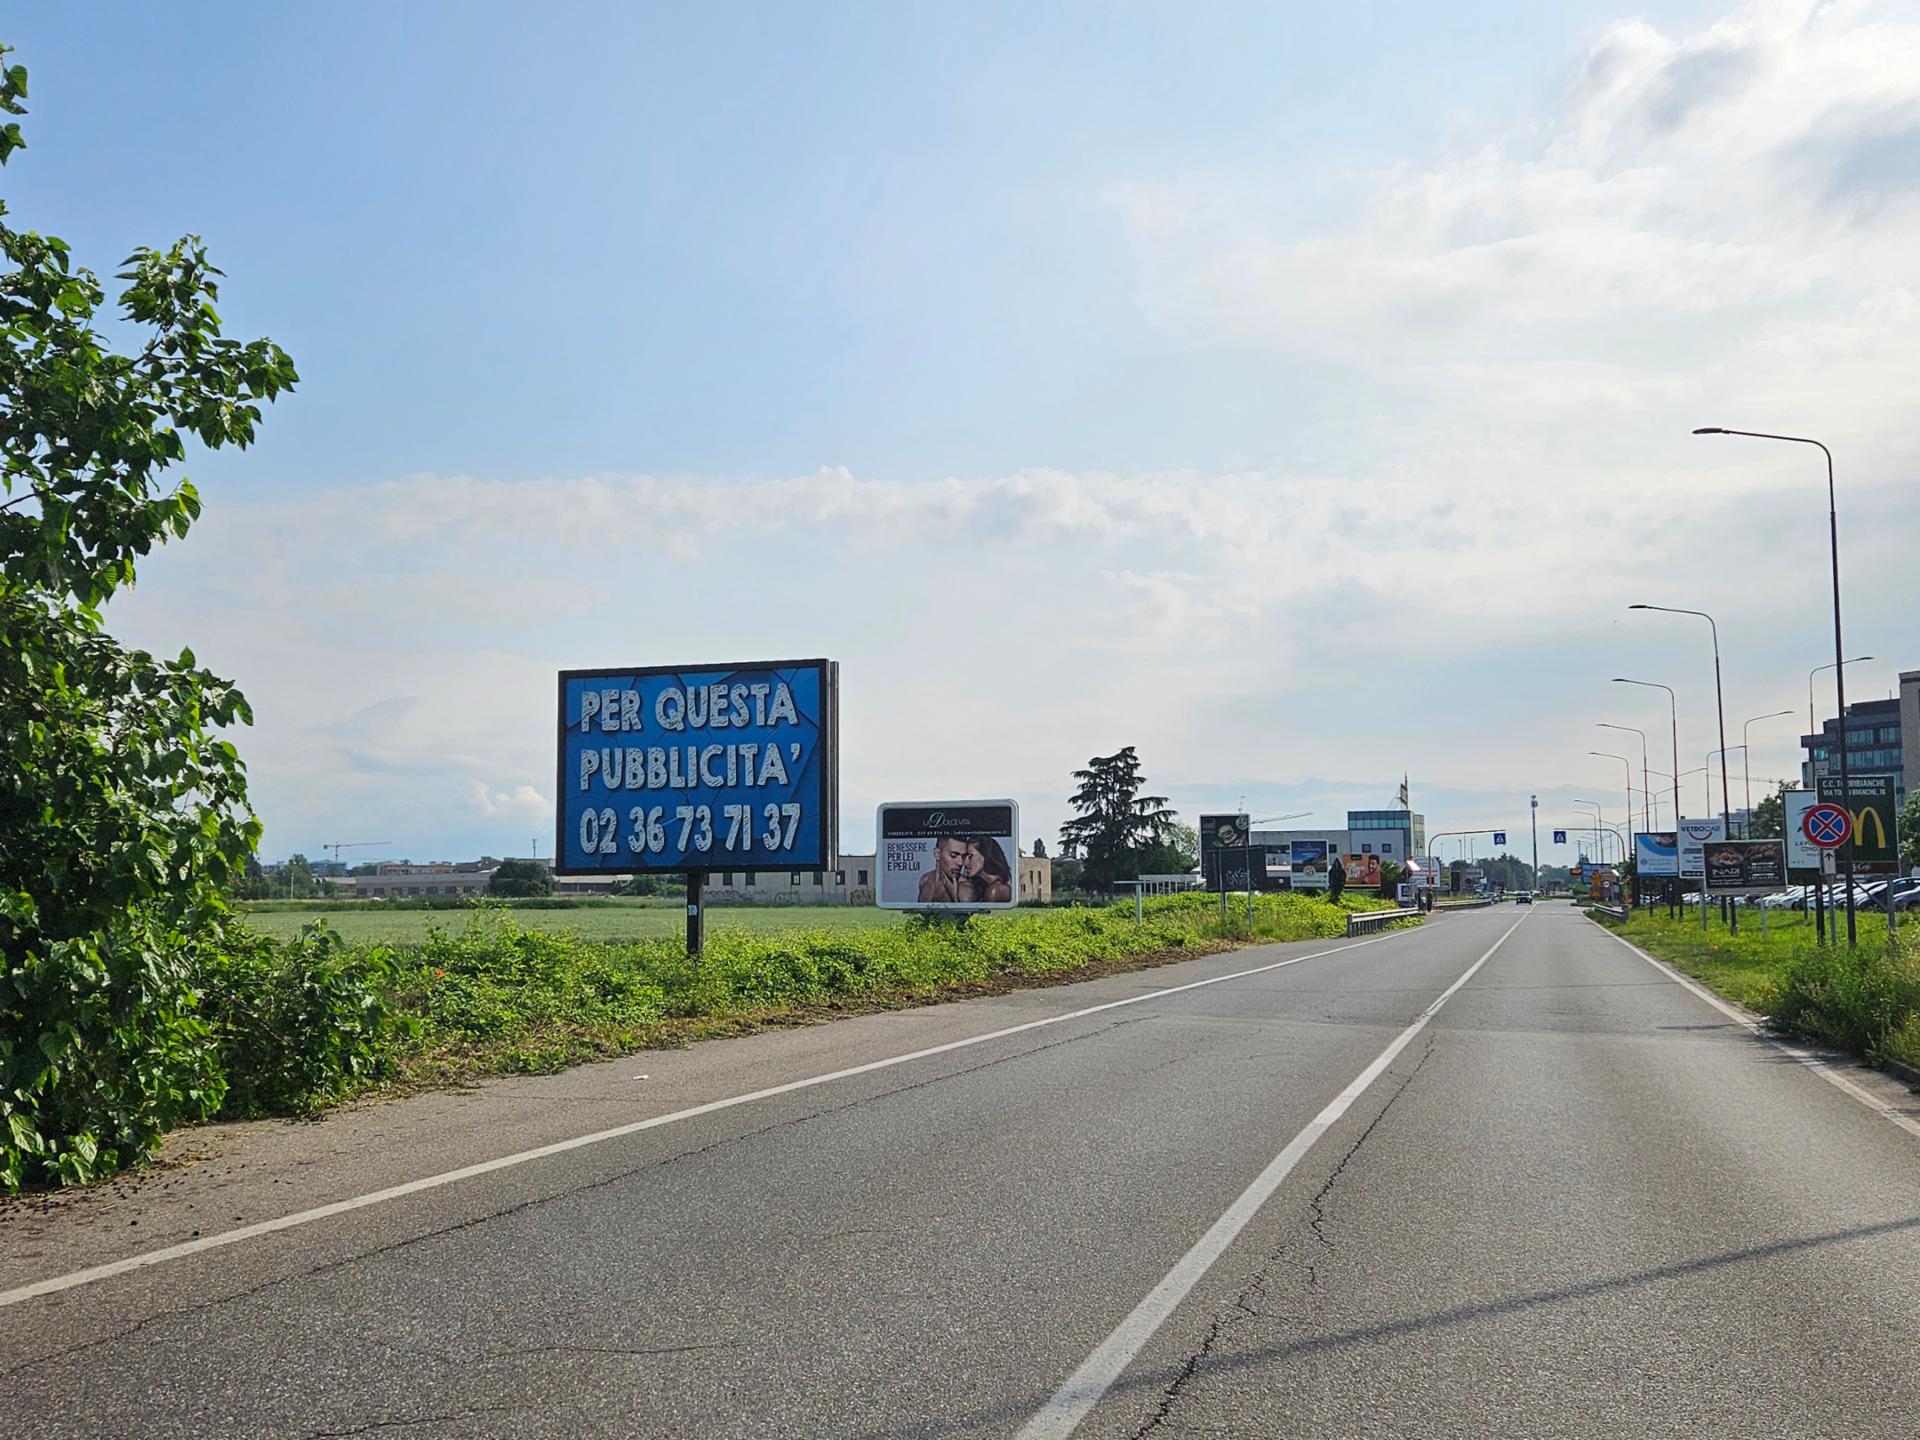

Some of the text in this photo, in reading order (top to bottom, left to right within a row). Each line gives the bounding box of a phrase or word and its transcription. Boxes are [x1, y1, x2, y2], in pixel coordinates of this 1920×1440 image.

[580, 683, 798, 733] PER QUESTA
[580, 742, 800, 791] PUBBLICITA'
[1836, 779, 1886, 788] TRIBIANCHE
[579, 803, 800, 854] 02 36 73 71 37
[1681, 825, 1720, 833] VETROCAR
[887, 842, 928, 853] BENESSERE
[887, 852, 914, 862] PER LEI
[887, 861, 920, 871] E PER LUI
